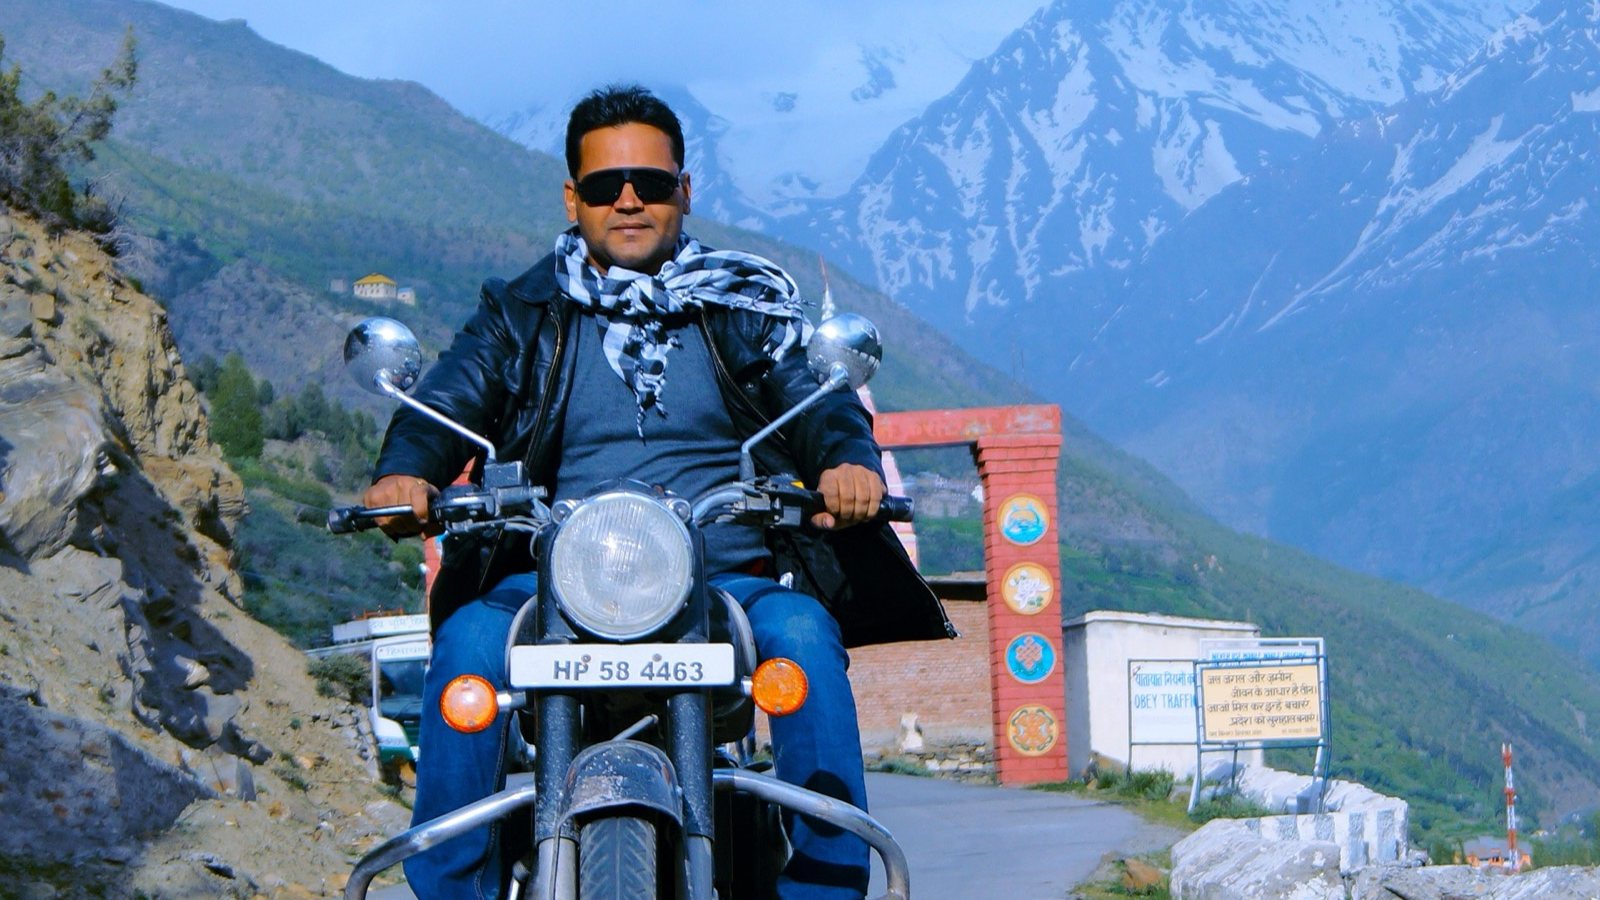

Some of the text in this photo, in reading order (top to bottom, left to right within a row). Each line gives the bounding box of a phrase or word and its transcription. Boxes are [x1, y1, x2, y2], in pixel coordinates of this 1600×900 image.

[553, 660, 704, 682] HP 58 4463
[1247, 670, 1265, 683] और
[1134, 693, 1158, 709] OBEY
